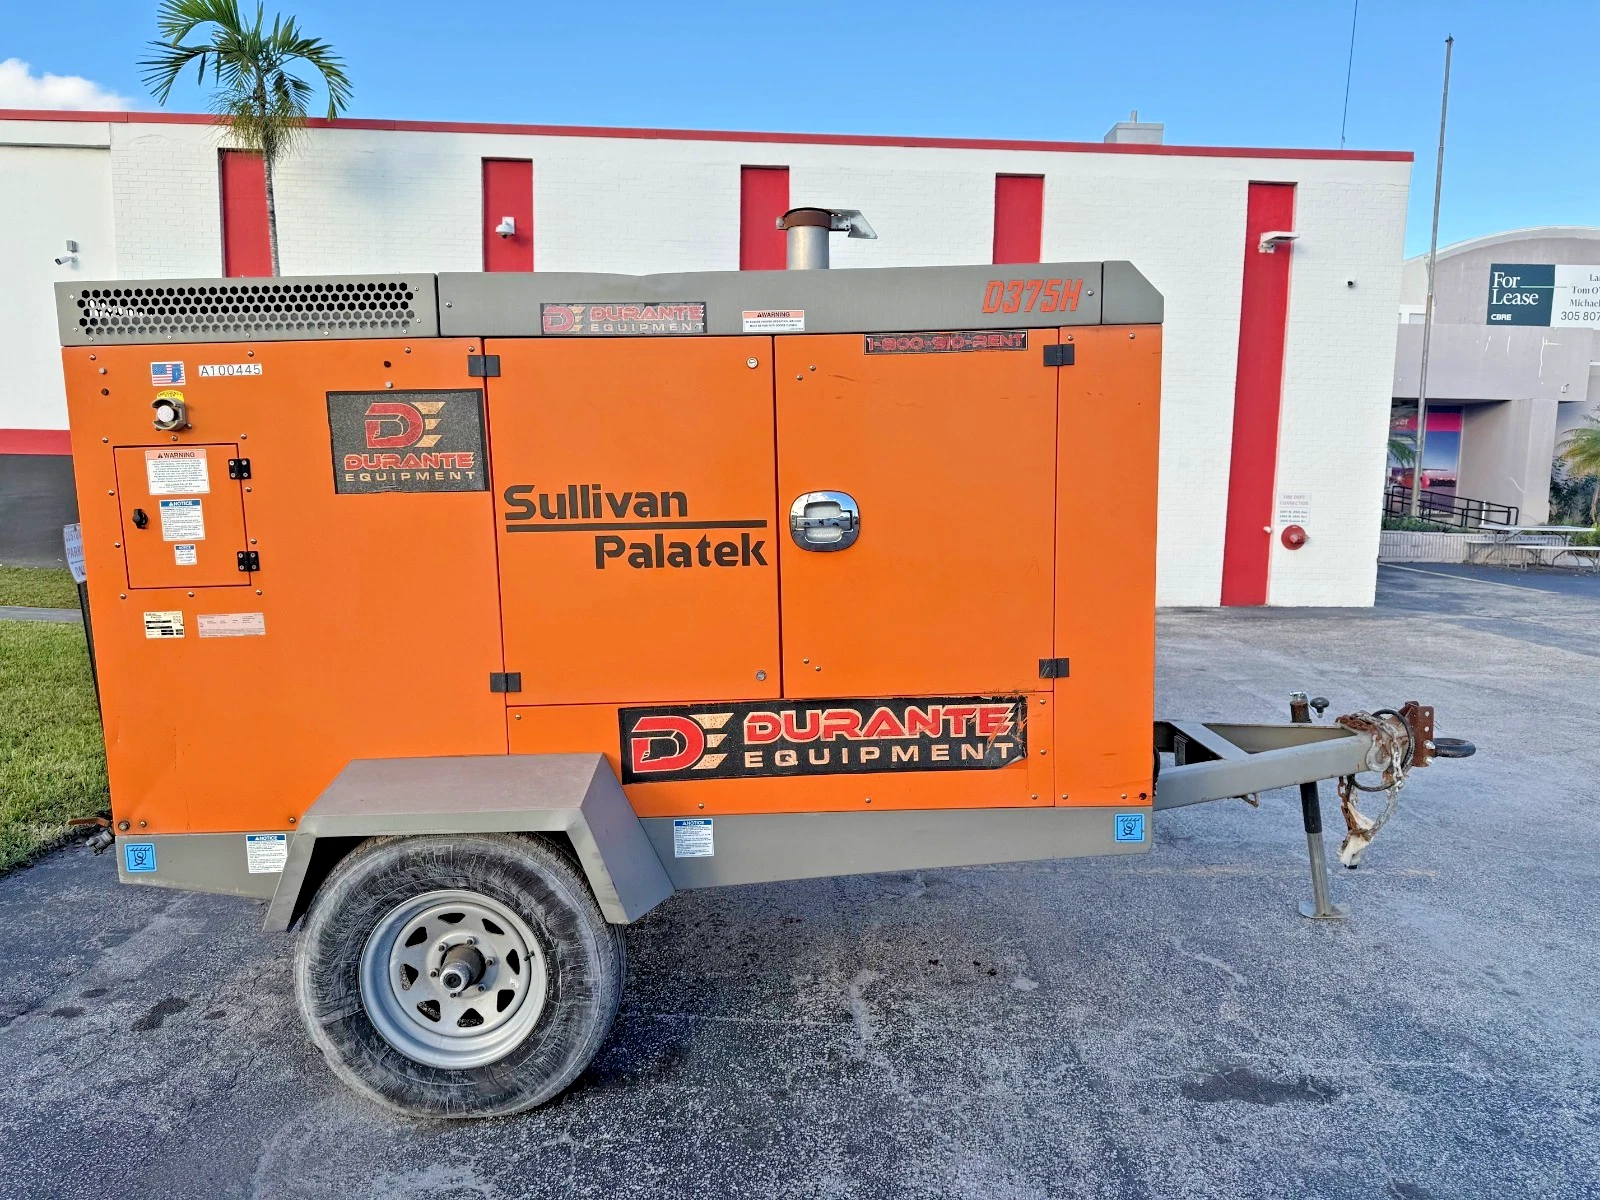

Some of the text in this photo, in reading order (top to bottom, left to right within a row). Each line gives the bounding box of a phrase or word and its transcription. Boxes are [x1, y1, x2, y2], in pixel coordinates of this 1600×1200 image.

[1492, 271, 1521, 289] For
[1589, 273, 1600, 281] La
[982, 279, 1083, 313] D375H
[1490, 288, 1539, 305] Lease
[1572, 286, 1590, 294] Tom
[590, 304, 705, 321] DURANTE
[1490, 313, 1512, 321] CBRE
[1560, 311, 1580, 321] 305
[590, 322, 705, 332] EQUIPMENT
[200, 364, 262, 377] A100445
[163, 451, 196, 459] WARNING
[344, 452, 475, 471] DURANTE
[345, 471, 476, 482] EQUIPMENT
[503, 484, 688, 521] Sullivan
[594, 533, 769, 569] Palatek
[743, 703, 1016, 745] DURANTE
[744, 742, 1014, 768] EQUIPMENT
